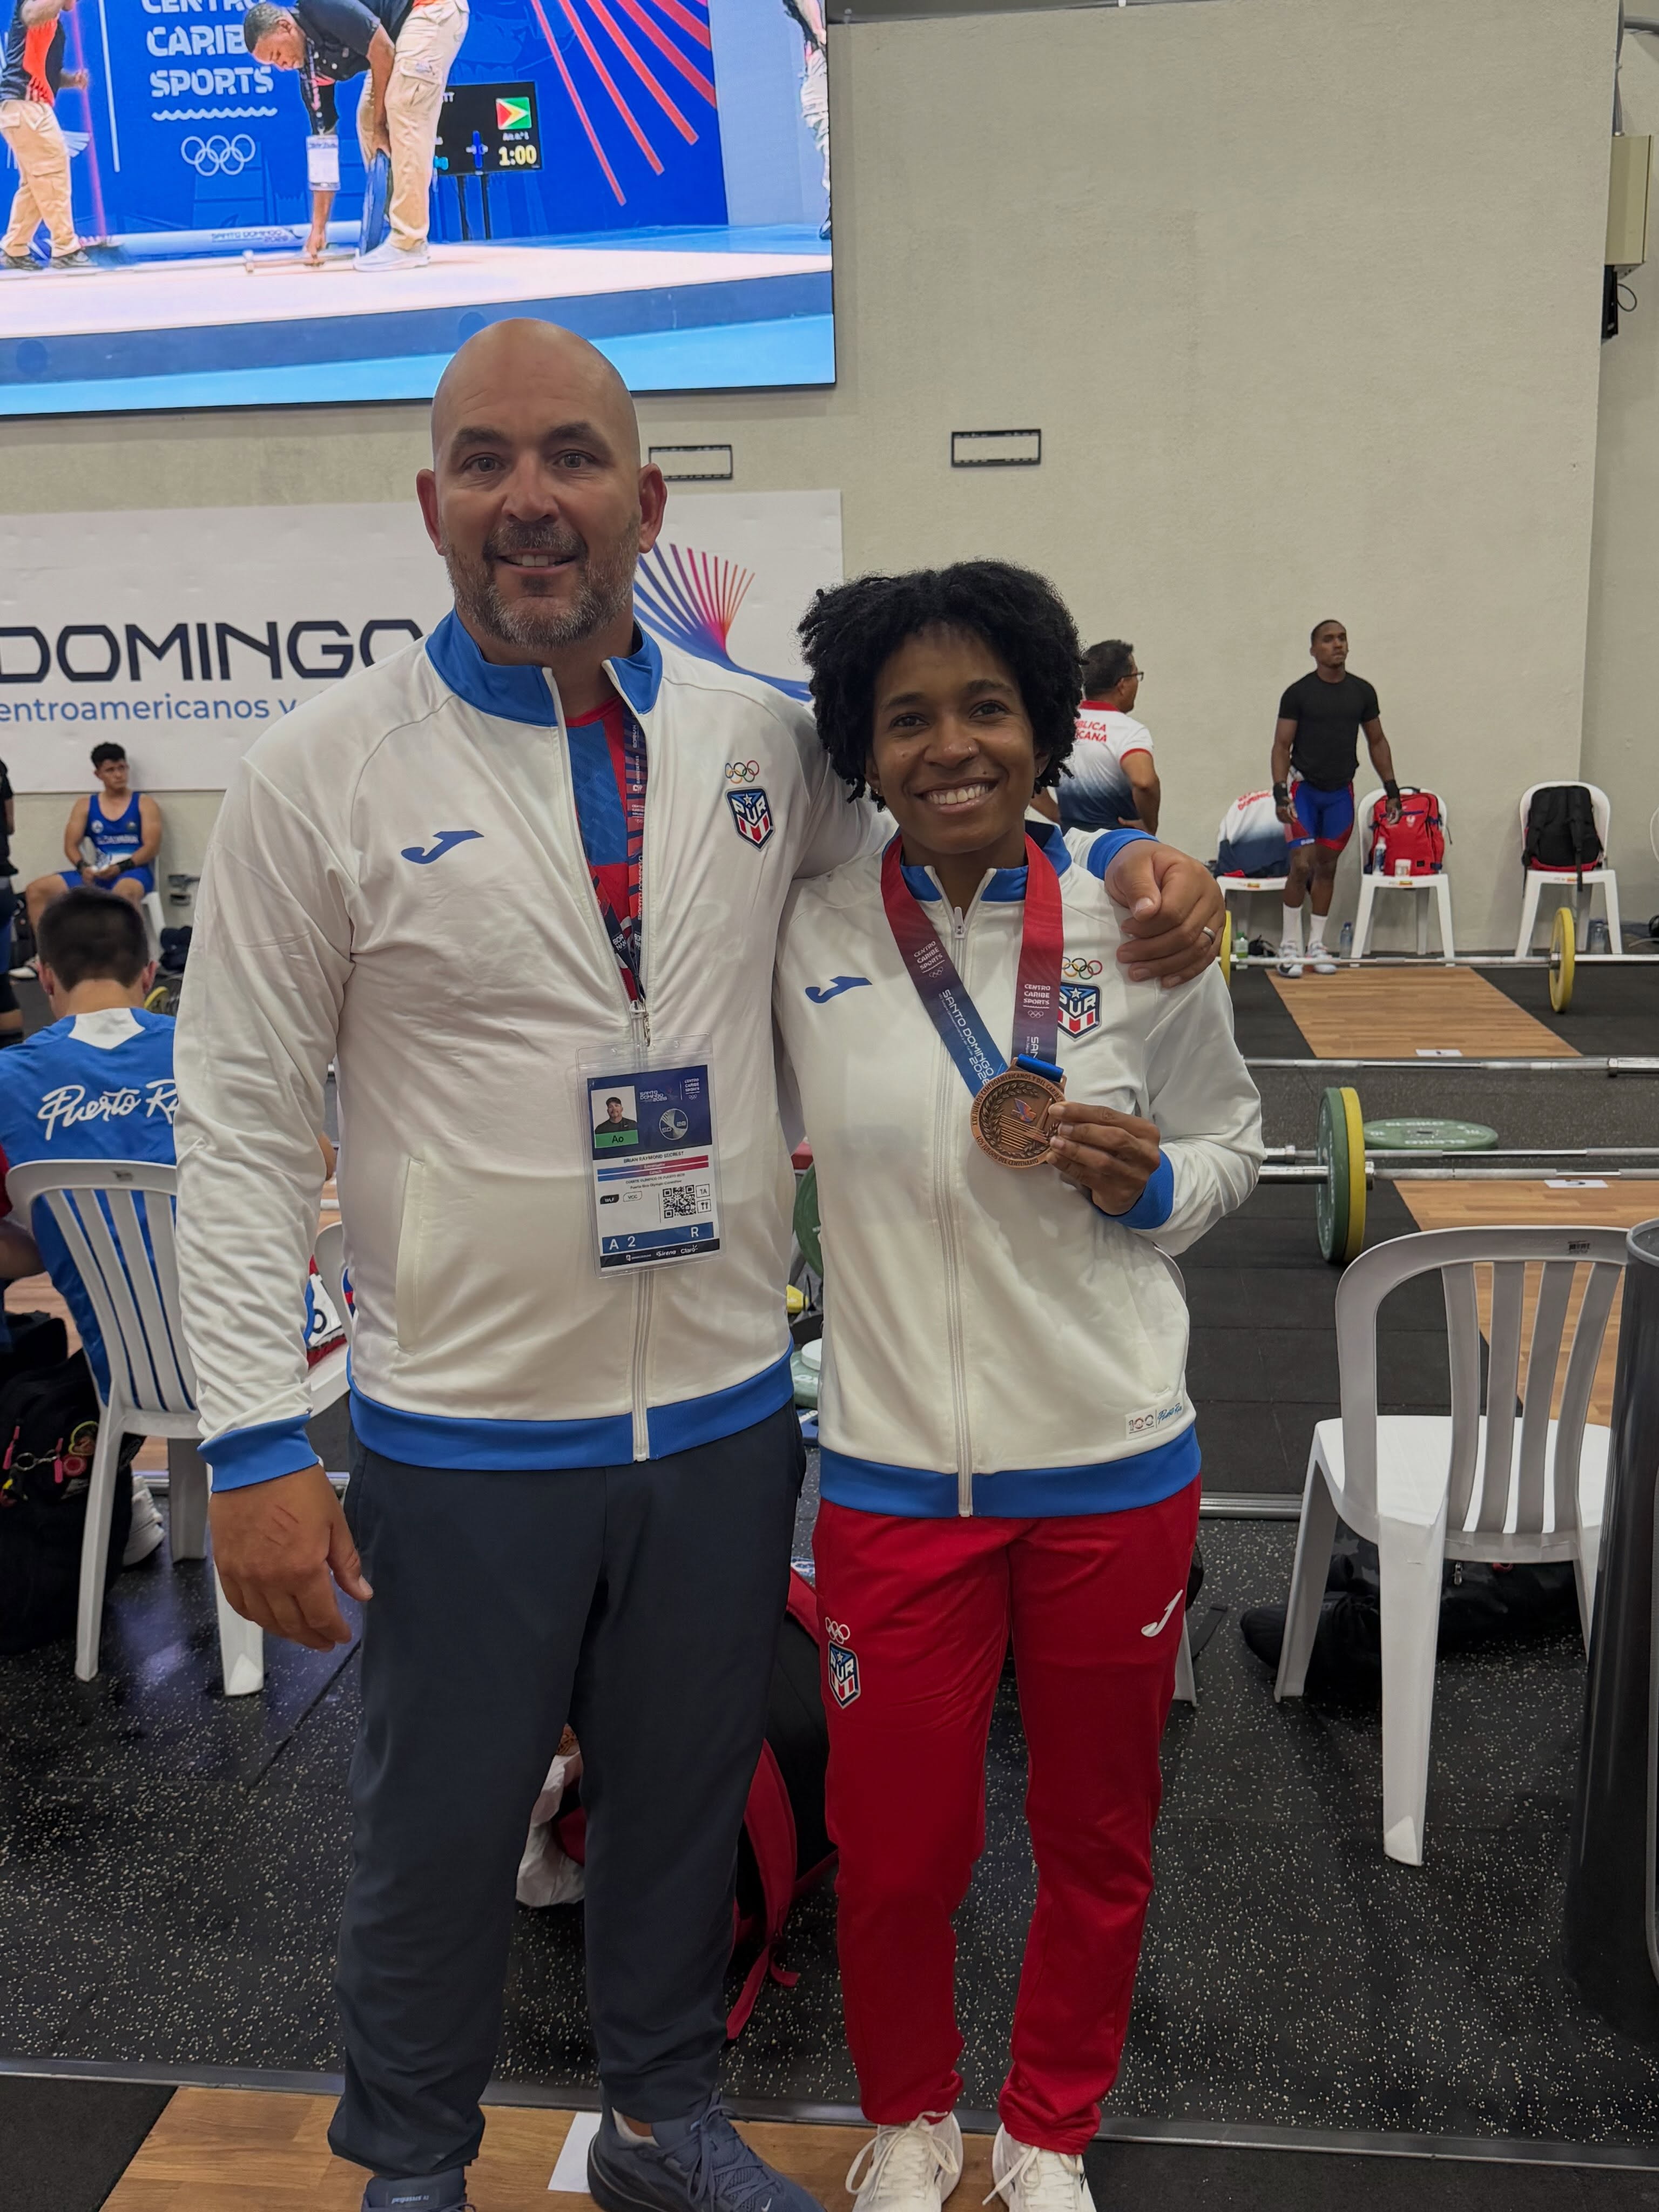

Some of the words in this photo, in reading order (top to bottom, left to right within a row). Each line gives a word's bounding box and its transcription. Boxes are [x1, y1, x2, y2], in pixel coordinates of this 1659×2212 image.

[150, 67, 274, 98] SPORTS
[498, 144, 537, 166] 1:00
[0, 619, 424, 683] DOMINGO
[731, 795, 766, 824] PUR
[914, 941, 936, 957] CENTRO
[917, 947, 940, 963] CARIBE
[920, 954, 943, 970] SPORTS
[942, 989, 966, 1027] SANTO
[962, 1028, 994, 1076] DOMINGO
[37, 1084, 141, 1141] Puerto
[611, 1135, 624, 1144] Ao
[609, 1239, 619, 1250] A
[628, 1236, 636, 1247] 2
[691, 1226, 699, 1238] R
[831, 1650, 854, 1683] PUR
